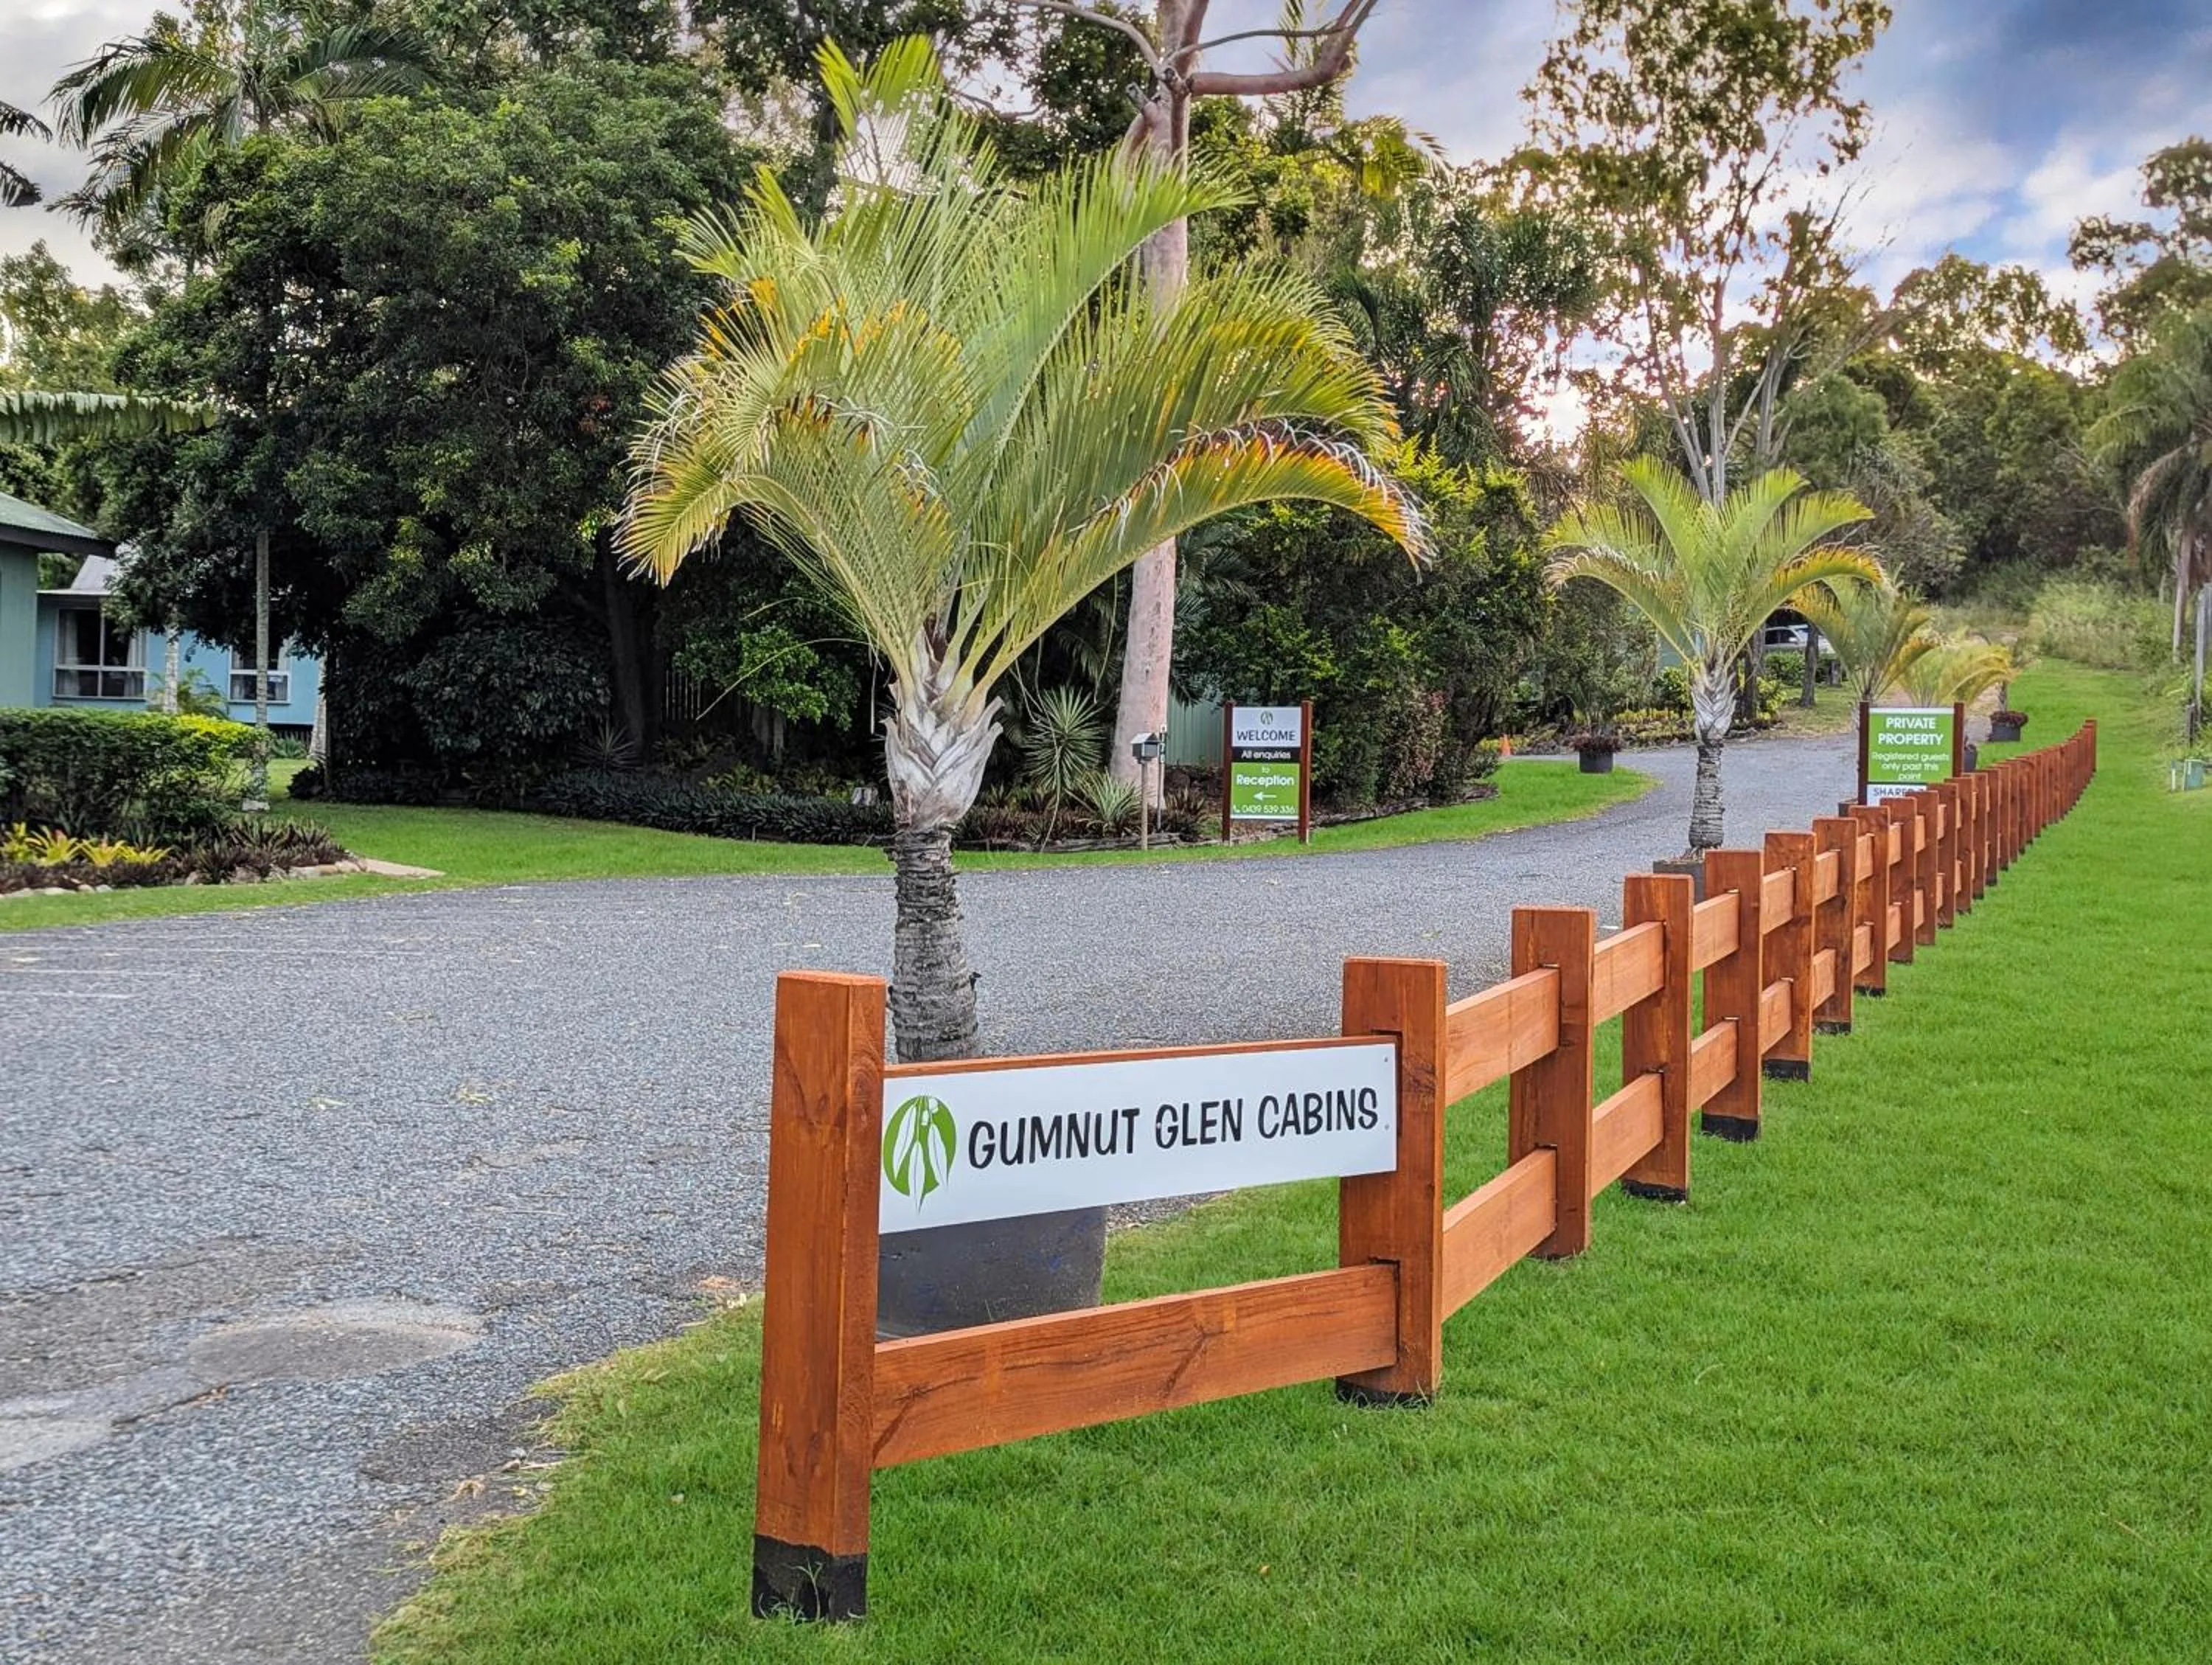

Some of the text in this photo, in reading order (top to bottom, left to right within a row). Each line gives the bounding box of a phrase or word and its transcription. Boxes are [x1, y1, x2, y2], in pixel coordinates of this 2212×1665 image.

[1885, 717, 1935, 729] PRIVATE
[1237, 730, 1295, 741] WELCOME
[1878, 733, 1944, 745] PROPERTY
[1241, 750, 1291, 760] All enquiries
[1871, 751, 1950, 762] Registered guests
[1882, 762, 1939, 773] only past this
[1237, 774, 1294, 788] Reception
[1898, 773, 1921, 782] point
[967, 1086, 1379, 1169] GUMNUT GLEN CABINS
